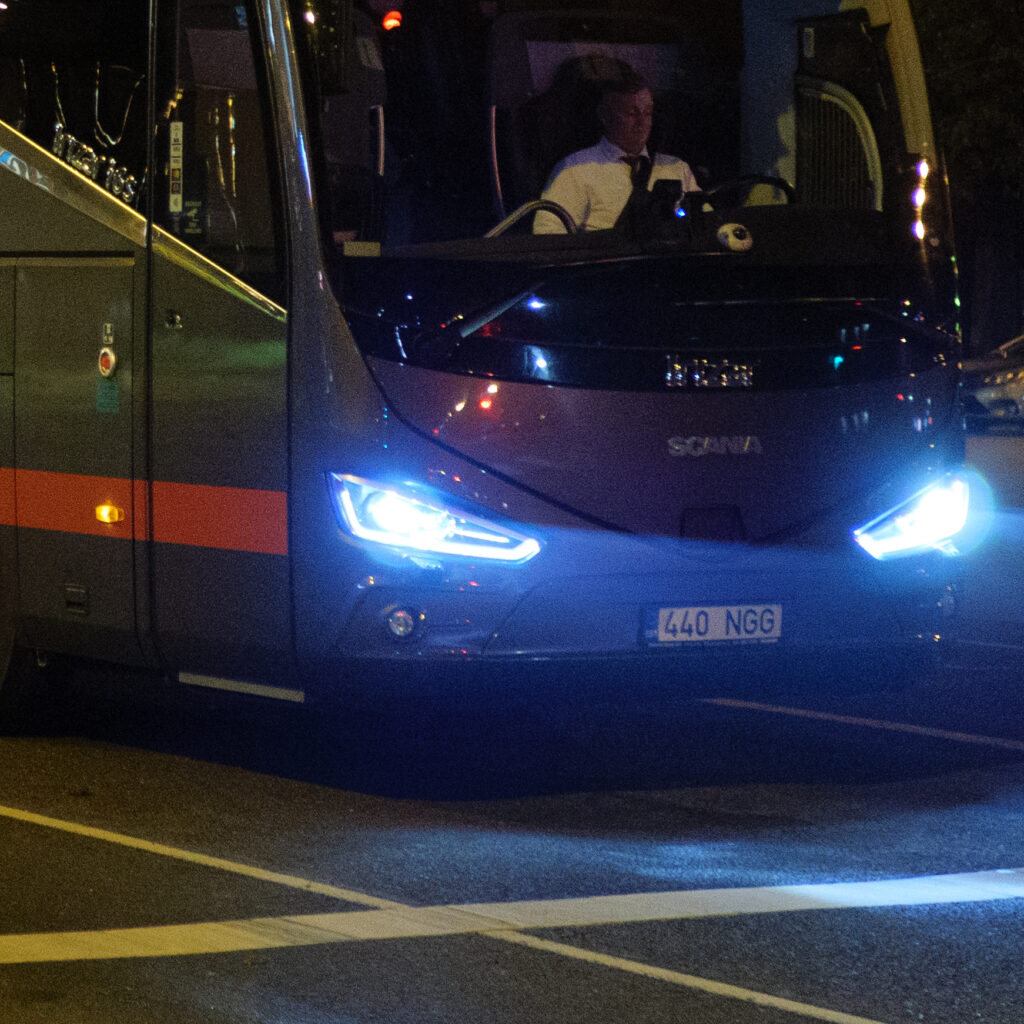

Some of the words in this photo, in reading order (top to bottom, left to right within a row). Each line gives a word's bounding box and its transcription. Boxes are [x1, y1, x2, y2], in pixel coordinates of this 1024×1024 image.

[667, 436, 763, 456] SCANIA
[664, 611, 709, 637] 440
[726, 607, 775, 635] NGG
